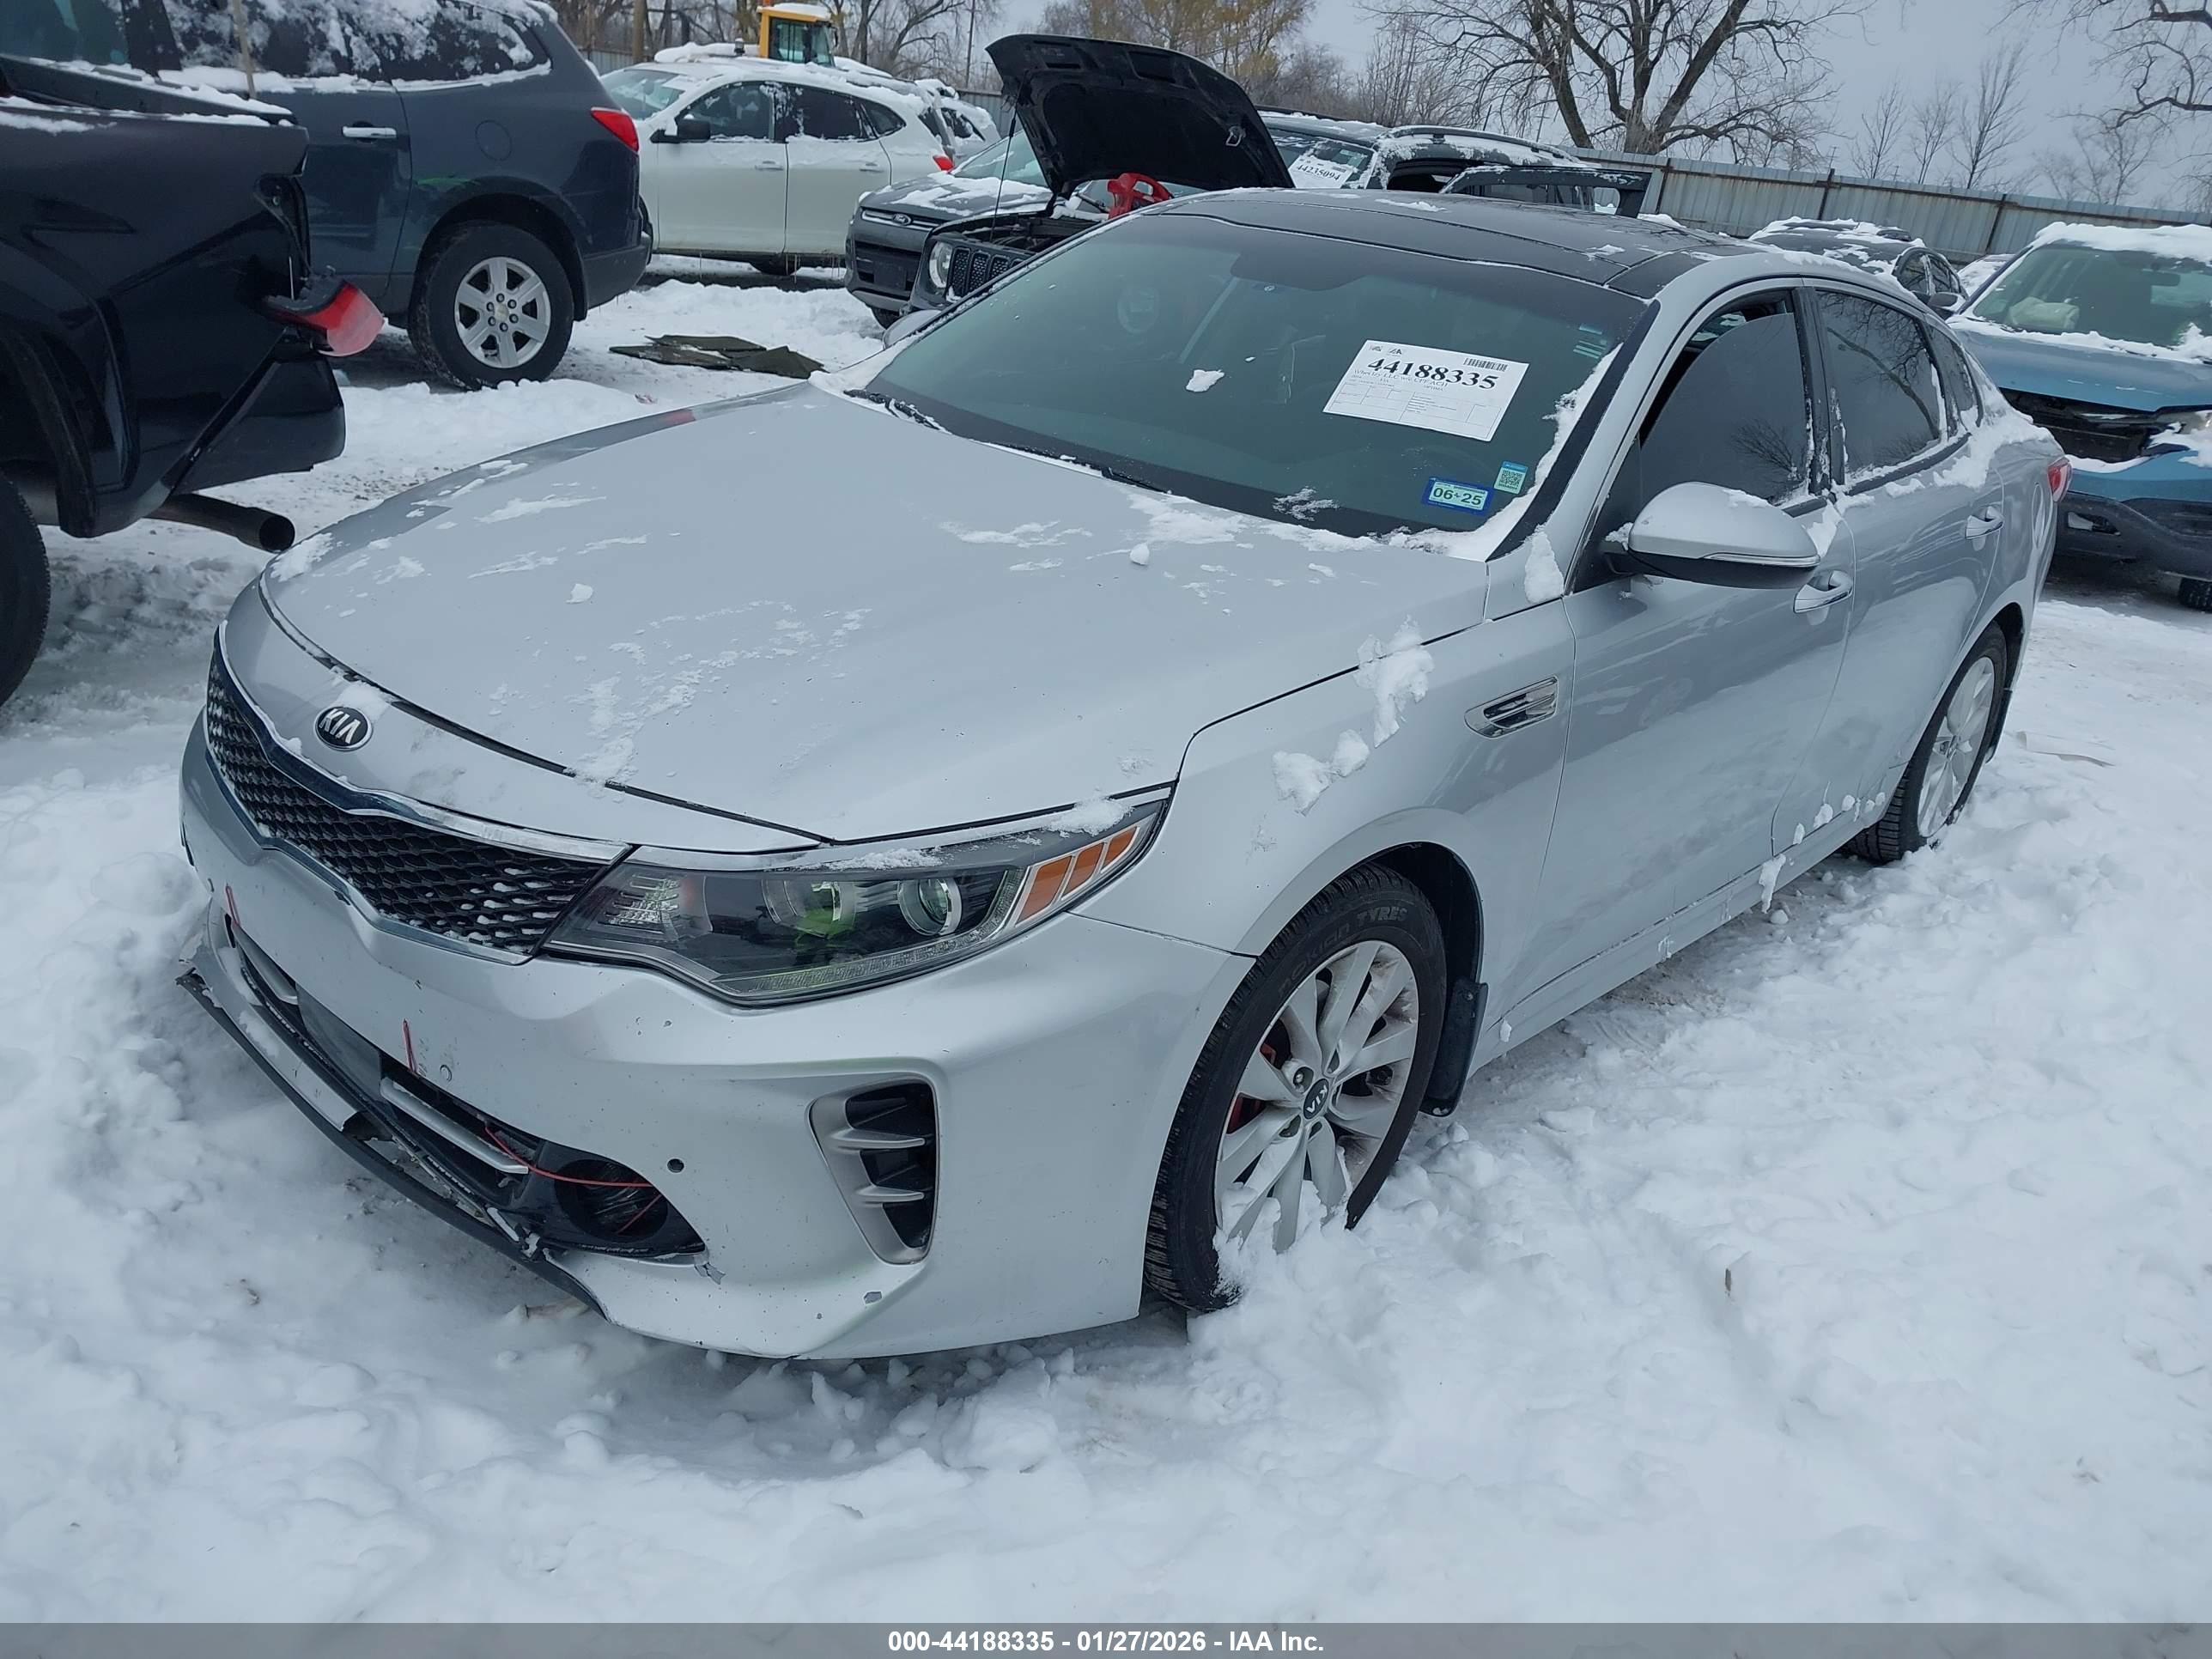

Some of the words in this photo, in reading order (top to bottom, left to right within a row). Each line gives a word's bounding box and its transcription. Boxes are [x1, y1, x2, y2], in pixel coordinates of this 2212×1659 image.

[1368, 359, 1499, 390] 44188335
[1433, 487, 1455, 500] 06
[1461, 493, 1484, 505] 25
[318, 708, 362, 744] KIA
[1305, 1084, 1328, 1114] KIA
